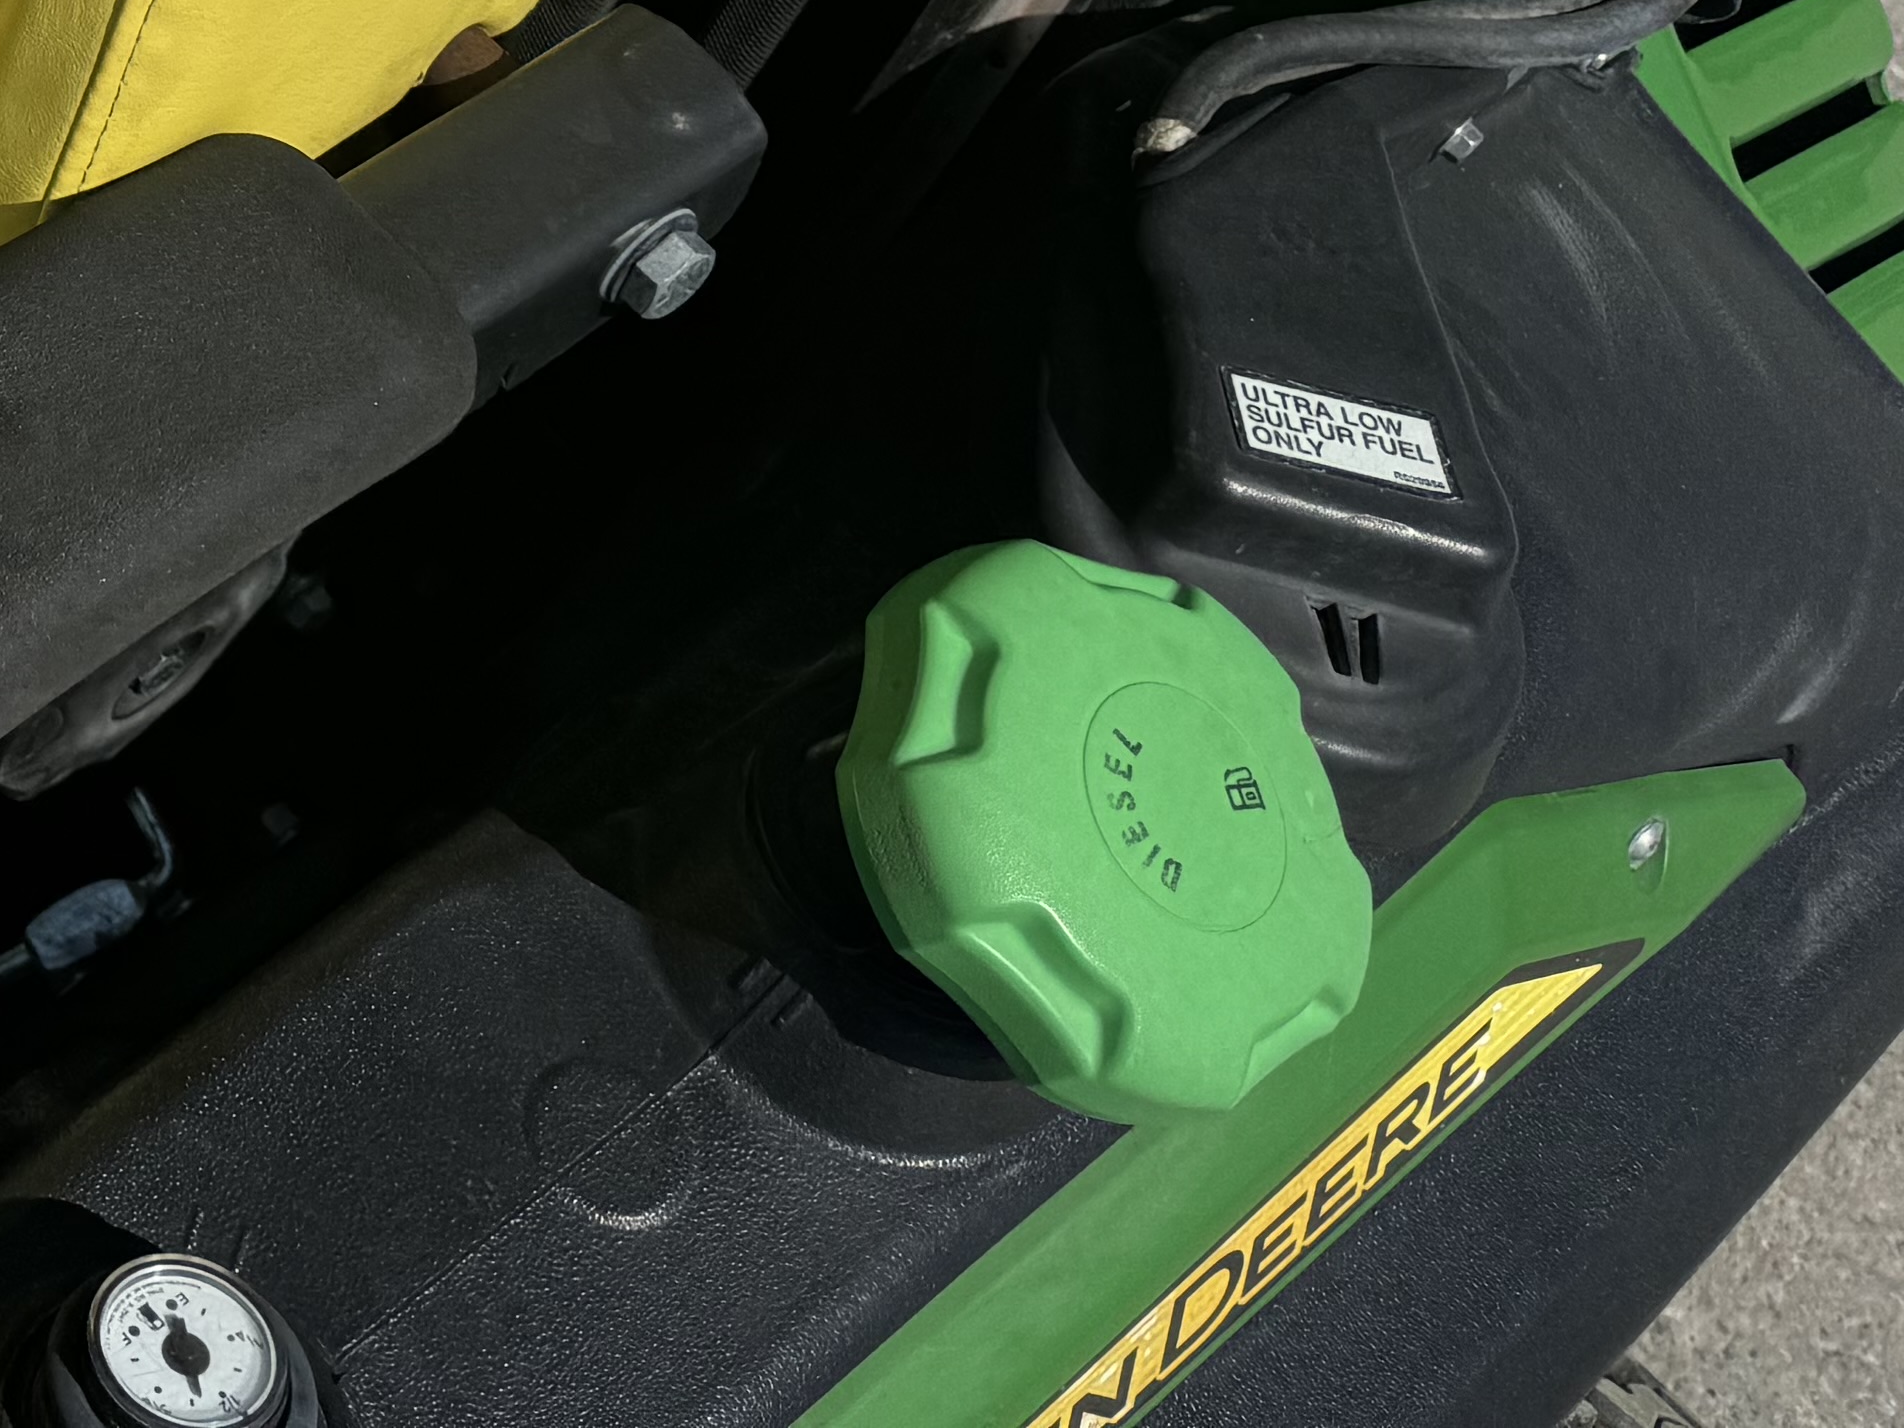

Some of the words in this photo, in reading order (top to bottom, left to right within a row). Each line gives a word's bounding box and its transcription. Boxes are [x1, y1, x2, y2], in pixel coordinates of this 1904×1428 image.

[1241, 383, 1334, 421] ULTRA
[1340, 406, 1402, 437] LOW
[1246, 404, 1356, 446] SULFUR
[1362, 432, 1434, 464] FUEL
[1252, 425, 1323, 457] ONLY
[1103, 727, 1184, 894] DIESEL
[1160, 1015, 1498, 1376] DEERE
[175, 1292, 190, 1307] E
[122, 1331, 132, 1347] F
[218, 1394, 242, 1414] 1/2
